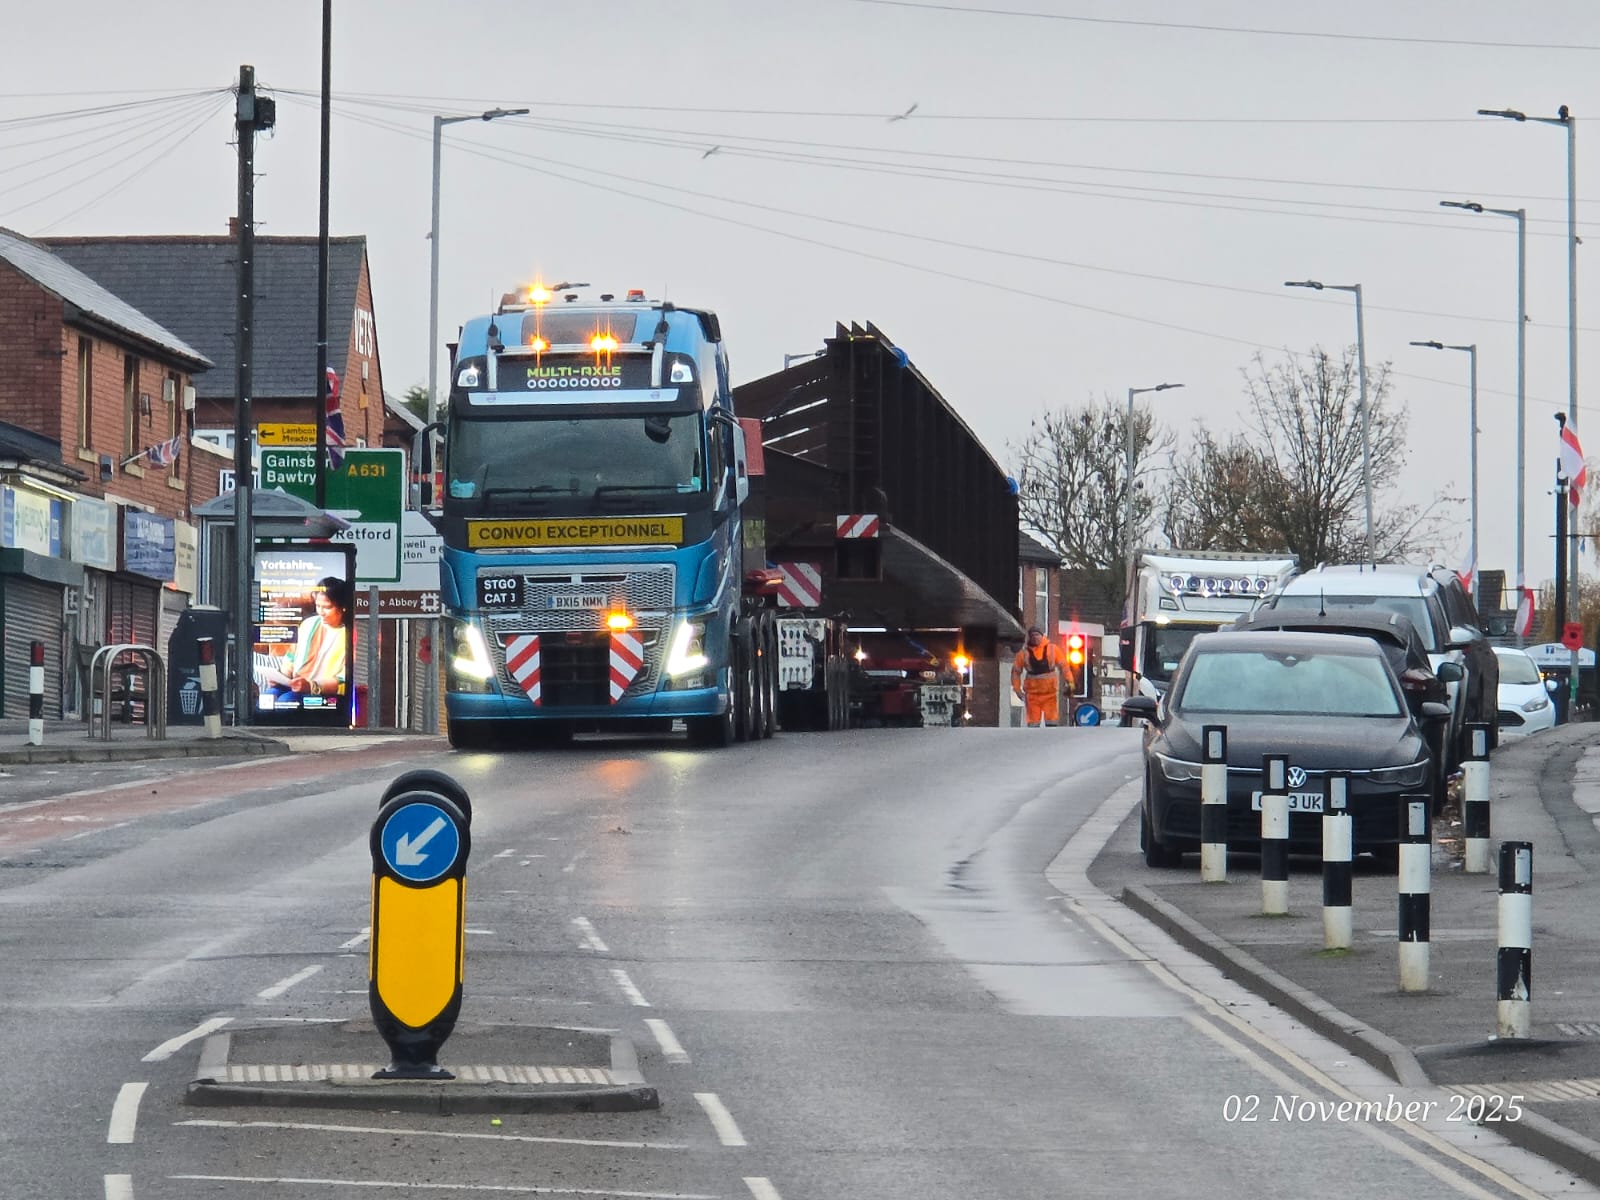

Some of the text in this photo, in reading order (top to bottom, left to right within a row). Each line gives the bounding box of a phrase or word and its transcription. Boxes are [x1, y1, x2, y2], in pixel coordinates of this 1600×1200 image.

[527, 366, 622, 377] MULTI-AXLE
[281, 426, 316, 434] Lambcot
[266, 470, 317, 485] Bawtry
[336, 528, 391, 540] Retford
[479, 524, 670, 540] CONVOI EXCEPTIONNEL
[403, 540, 426, 549] well
[403, 551, 422, 559] ton
[484, 579, 517, 590] STGO
[356, 597, 418, 608] Roe Abbey
[484, 592, 516, 604] CAT 3
